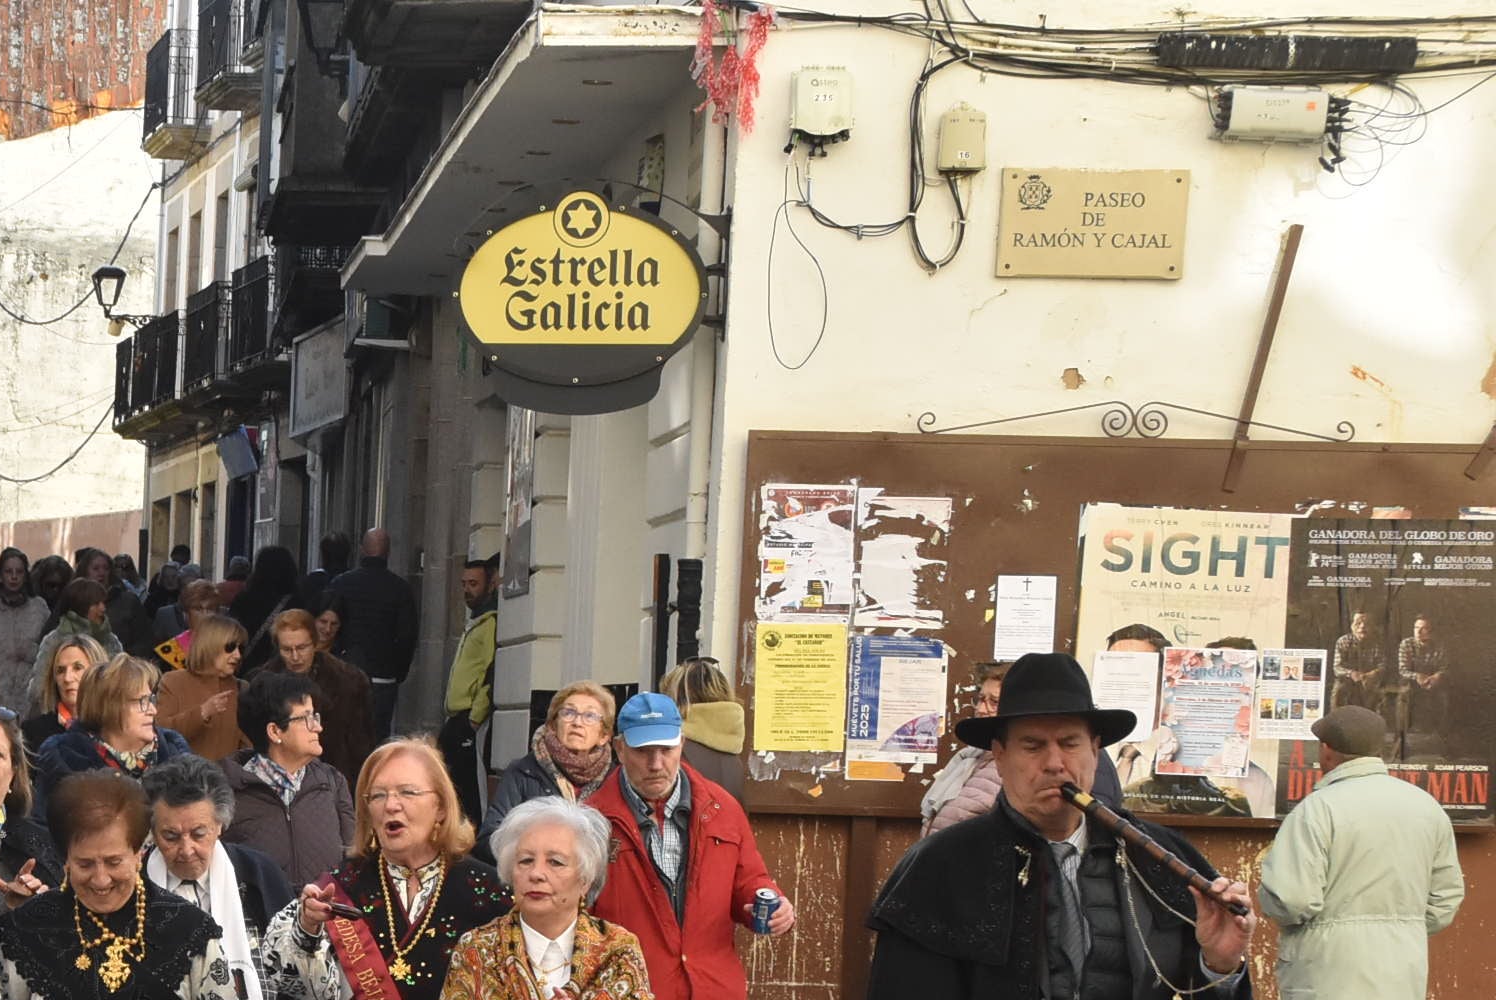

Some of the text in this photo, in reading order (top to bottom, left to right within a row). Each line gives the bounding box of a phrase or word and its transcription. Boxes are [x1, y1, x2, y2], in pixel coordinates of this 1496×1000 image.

[1084, 192, 1146, 208] PASEO
[1081, 212, 1106, 227] DE
[1012, 228, 1172, 249] RAMÓN Y CAJAL
[500, 246, 661, 287] Estrella
[505, 290, 651, 332] Galicia
[1308, 529, 1495, 541] GANADORA DEL GLOBO DE ORO
[1100, 529, 1290, 579] SIGHT
[1434, 556, 1493, 564] GANADORA
[1130, 579, 1251, 593] CAMINO A LA LUZ
[855, 636, 863, 664] SALUD
[855, 665, 861, 676] TU
[860, 703, 870, 737] 2025
[1289, 740, 1303, 768] A
[1427, 772, 1489, 803] MAN
[334, 918, 367, 964] EDESA
